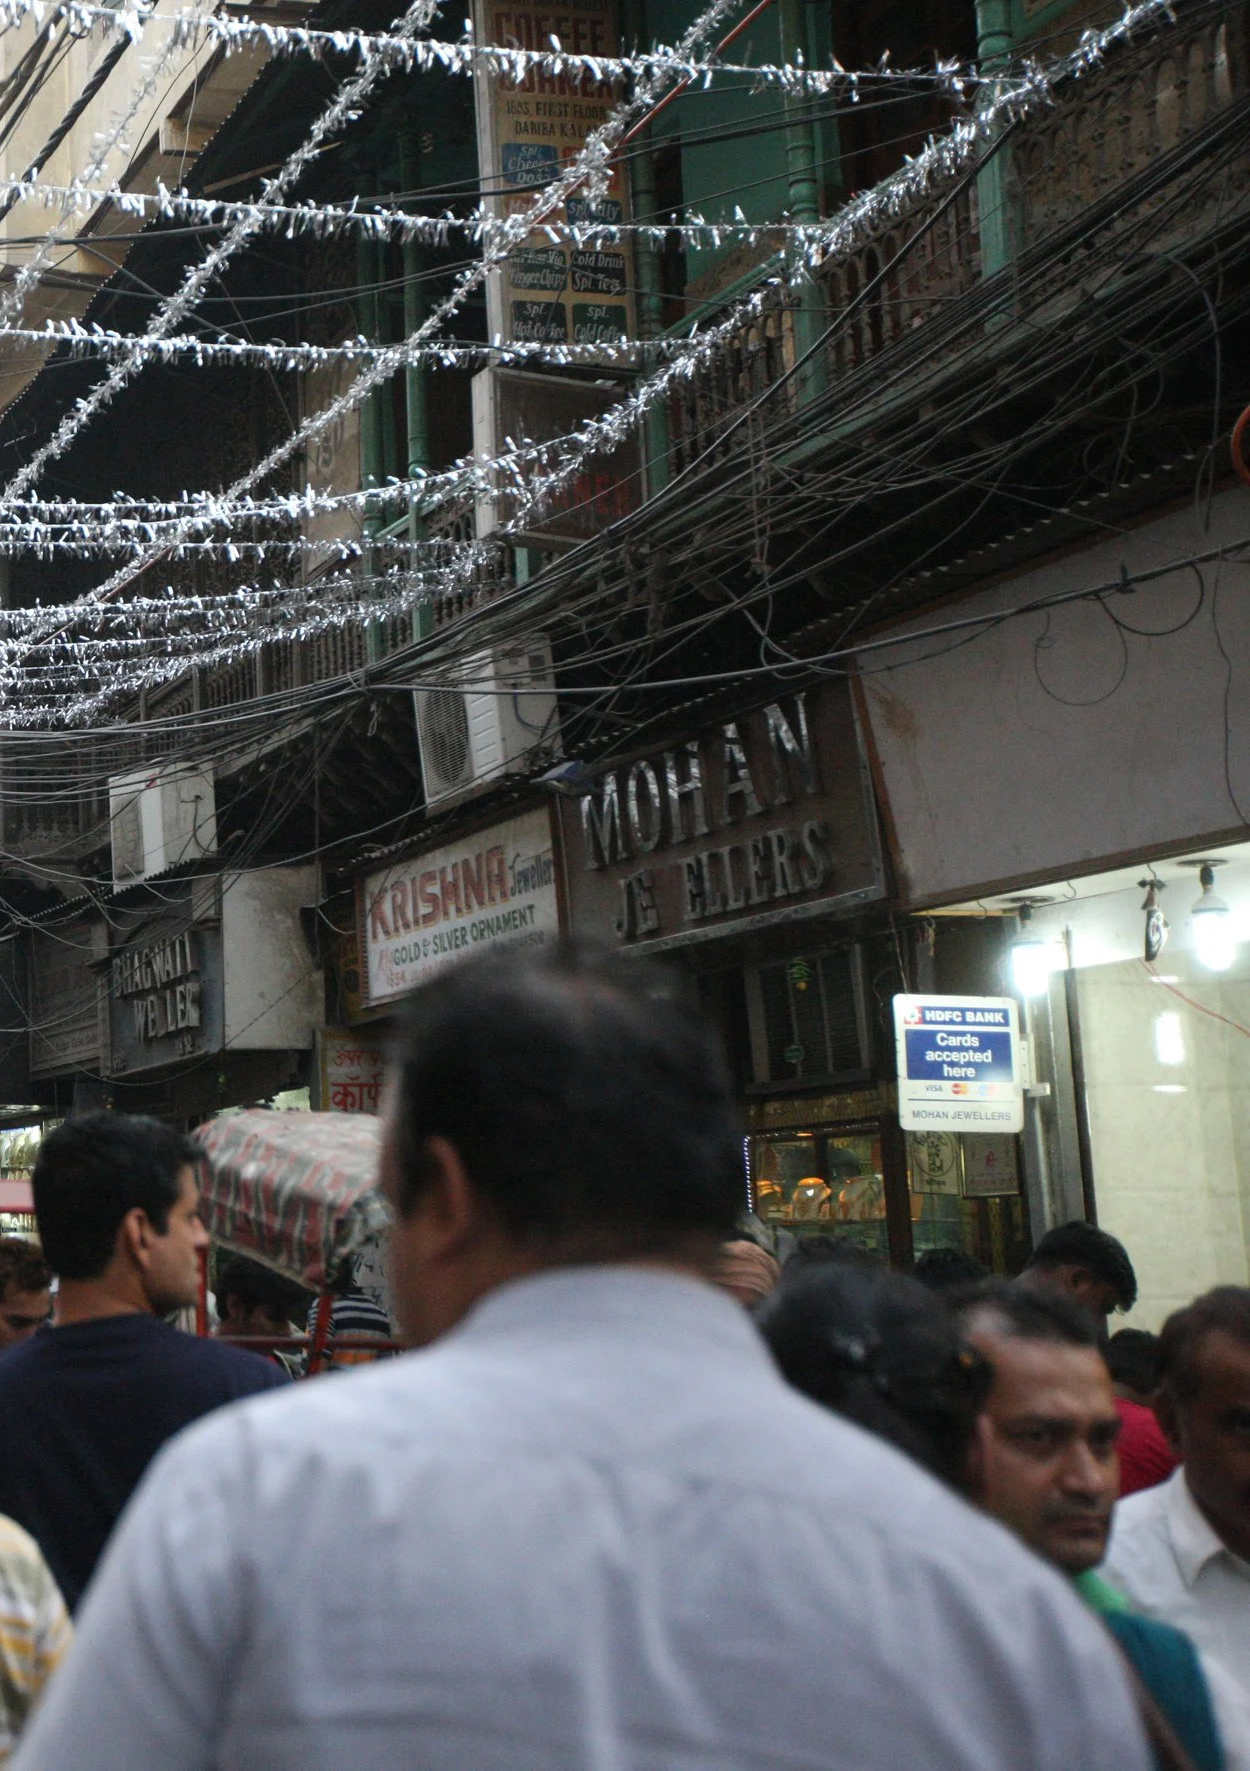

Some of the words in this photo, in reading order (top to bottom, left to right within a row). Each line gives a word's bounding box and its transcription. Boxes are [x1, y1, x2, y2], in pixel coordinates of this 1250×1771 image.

[495, 12, 605, 57] COFFEE
[573, 104, 607, 119] FLOOR
[515, 121, 555, 136] DARIBA
[580, 692, 820, 871] MOHAN
[369, 845, 510, 943] KRISHNA
[394, 942, 421, 966] GOLD
[433, 926, 470, 956] SILVER
[470, 904, 536, 942] ORNAMENT
[925, 1010, 962, 1022] HDFC
[965, 1011, 1005, 1023] BANK
[936, 1033, 980, 1046] Cards
[925, 1049, 992, 1065] accepted
[943, 1064, 976, 1078] here
[925, 1084, 944, 1092] VISA
[912, 1110, 949, 1119] MOHAN
[951, 1111, 1012, 1121] JEWELLERS
